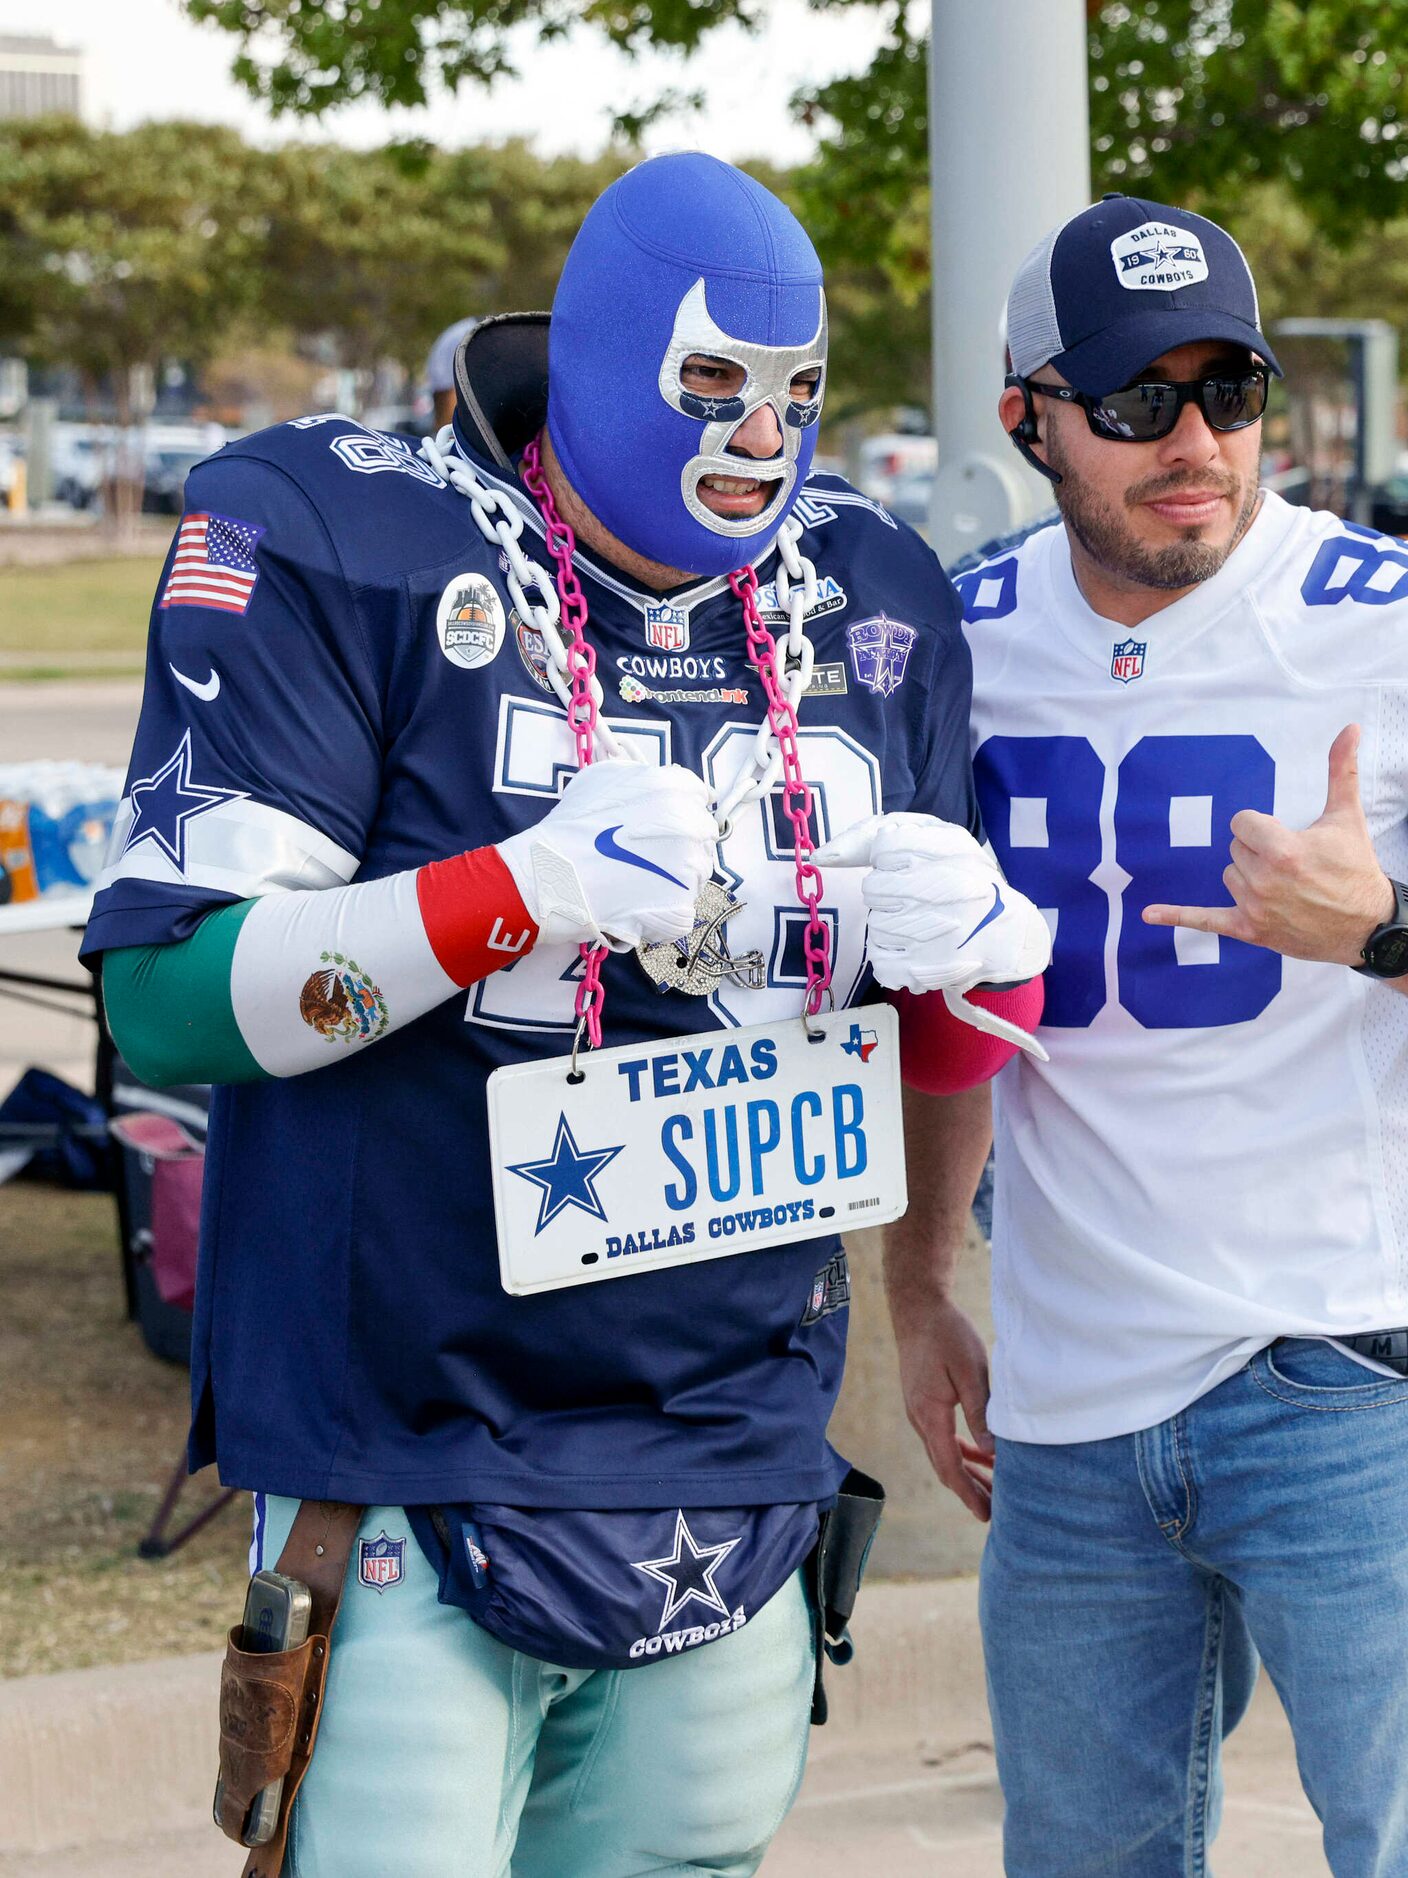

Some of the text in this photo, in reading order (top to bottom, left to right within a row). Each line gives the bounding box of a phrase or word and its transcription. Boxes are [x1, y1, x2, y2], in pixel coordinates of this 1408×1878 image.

[1131, 228, 1177, 242] DALLAS
[1126, 248, 1197, 267] 19 60
[1140, 270, 1194, 285] COWBOYS
[826, 598, 841, 609] Bar
[651, 623, 683, 650] NFL
[850, 622, 916, 646] ROWDY
[616, 655, 726, 679] COWBOYS
[1113, 656, 1141, 678] NFL
[973, 735, 1283, 1030] 88
[487, 916, 531, 953] E
[618, 1038, 778, 1102] TEXAS
[660, 1083, 868, 1211] SUPCB
[606, 1199, 815, 1259] DALLAS COWBOYS
[364, 1558, 399, 1583] NFL
[629, 1605, 748, 1659] COWBOYS
